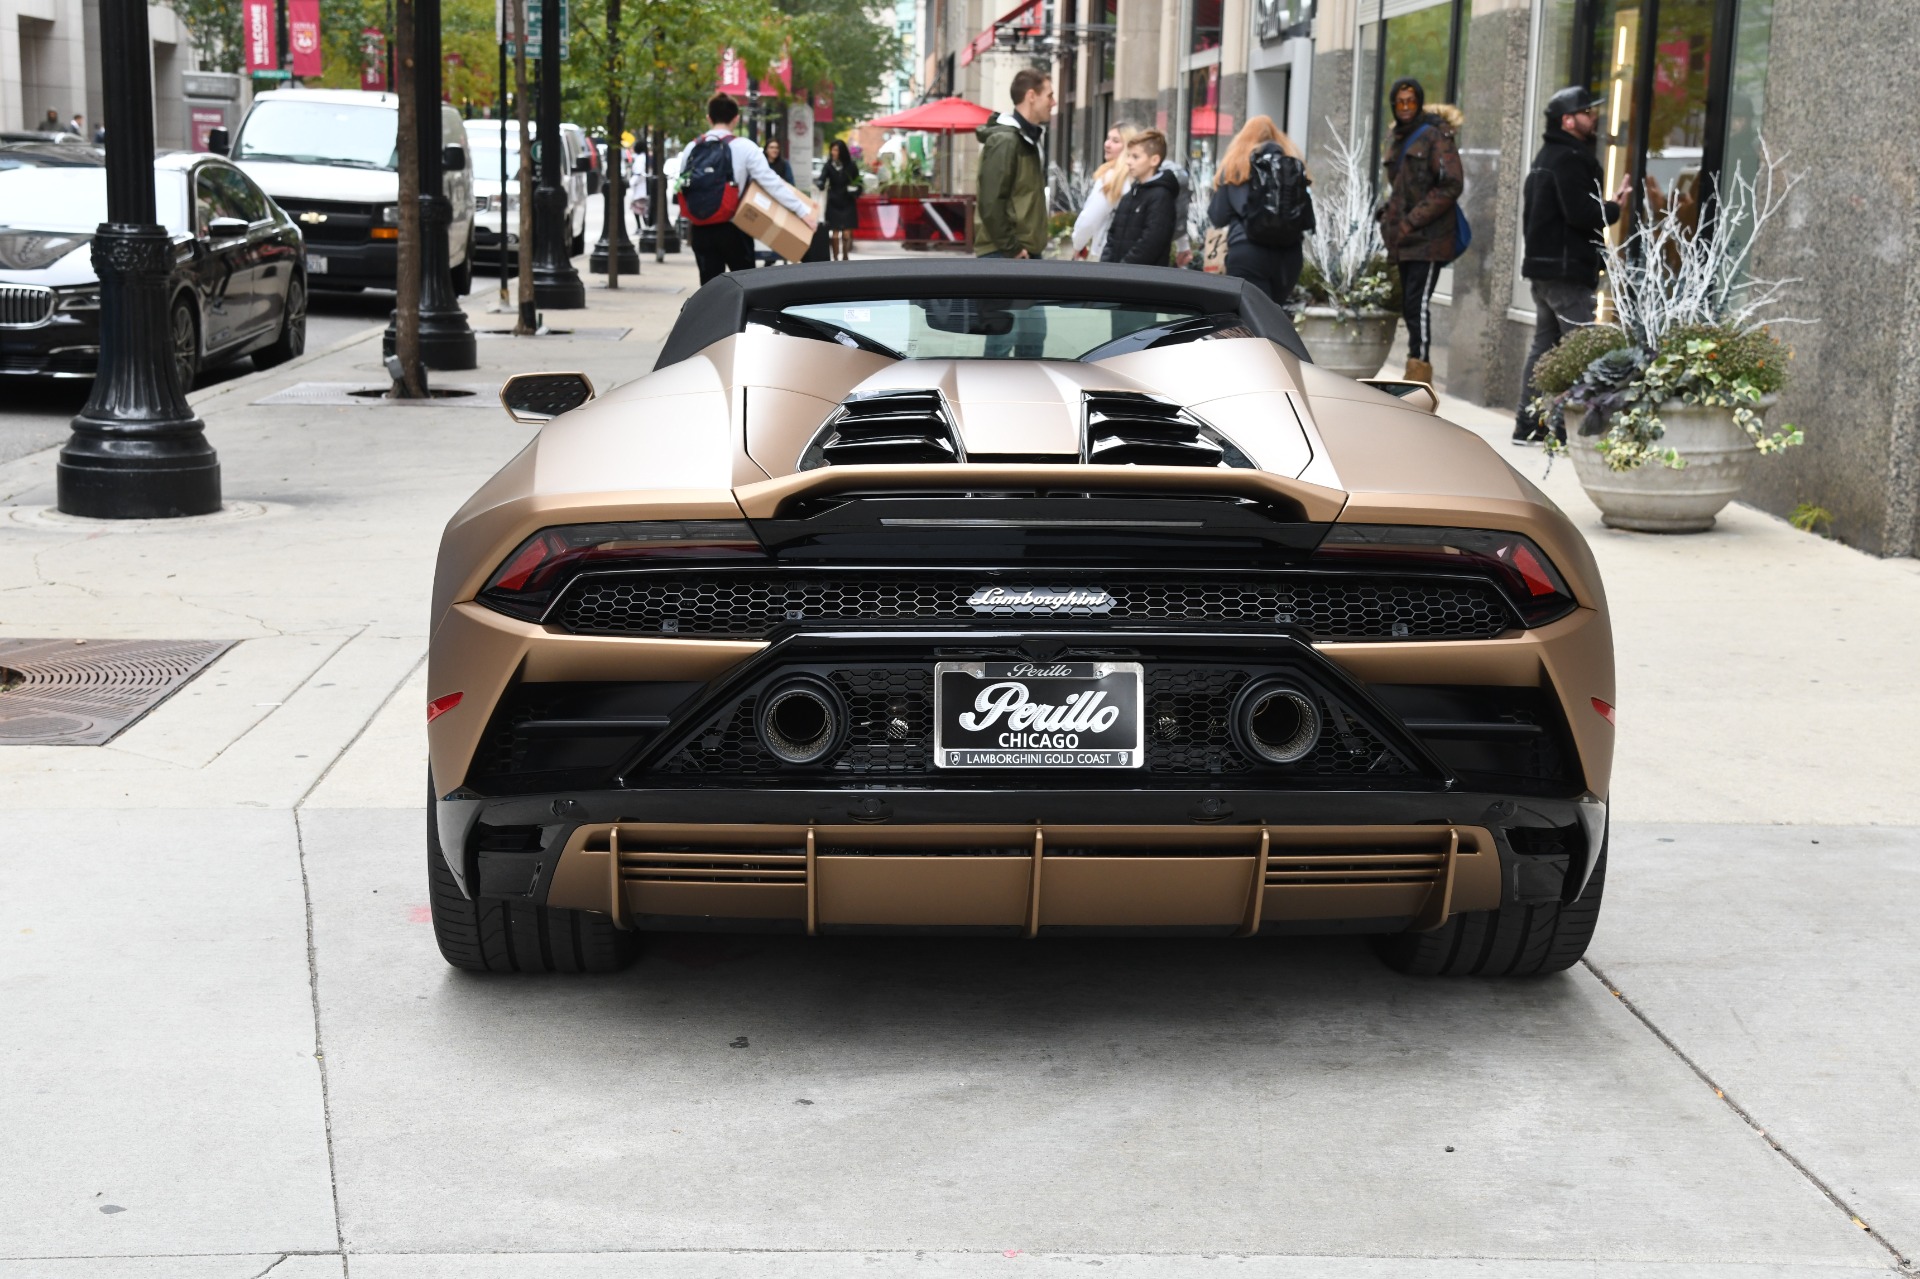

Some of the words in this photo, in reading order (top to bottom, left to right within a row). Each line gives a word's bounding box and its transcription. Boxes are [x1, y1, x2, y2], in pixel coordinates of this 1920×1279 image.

[251, 4, 263, 65] WELCOME
[969, 587, 1107, 610] Lamborghini
[1006, 663, 1073, 677] Perillo
[958, 682, 1120, 733] Perillo
[998, 732, 1079, 749] CHICAGO
[967, 753, 1042, 764] LAMBORGHINI
[1044, 753, 1074, 764] GOLD
[1077, 753, 1112, 764] COAST
